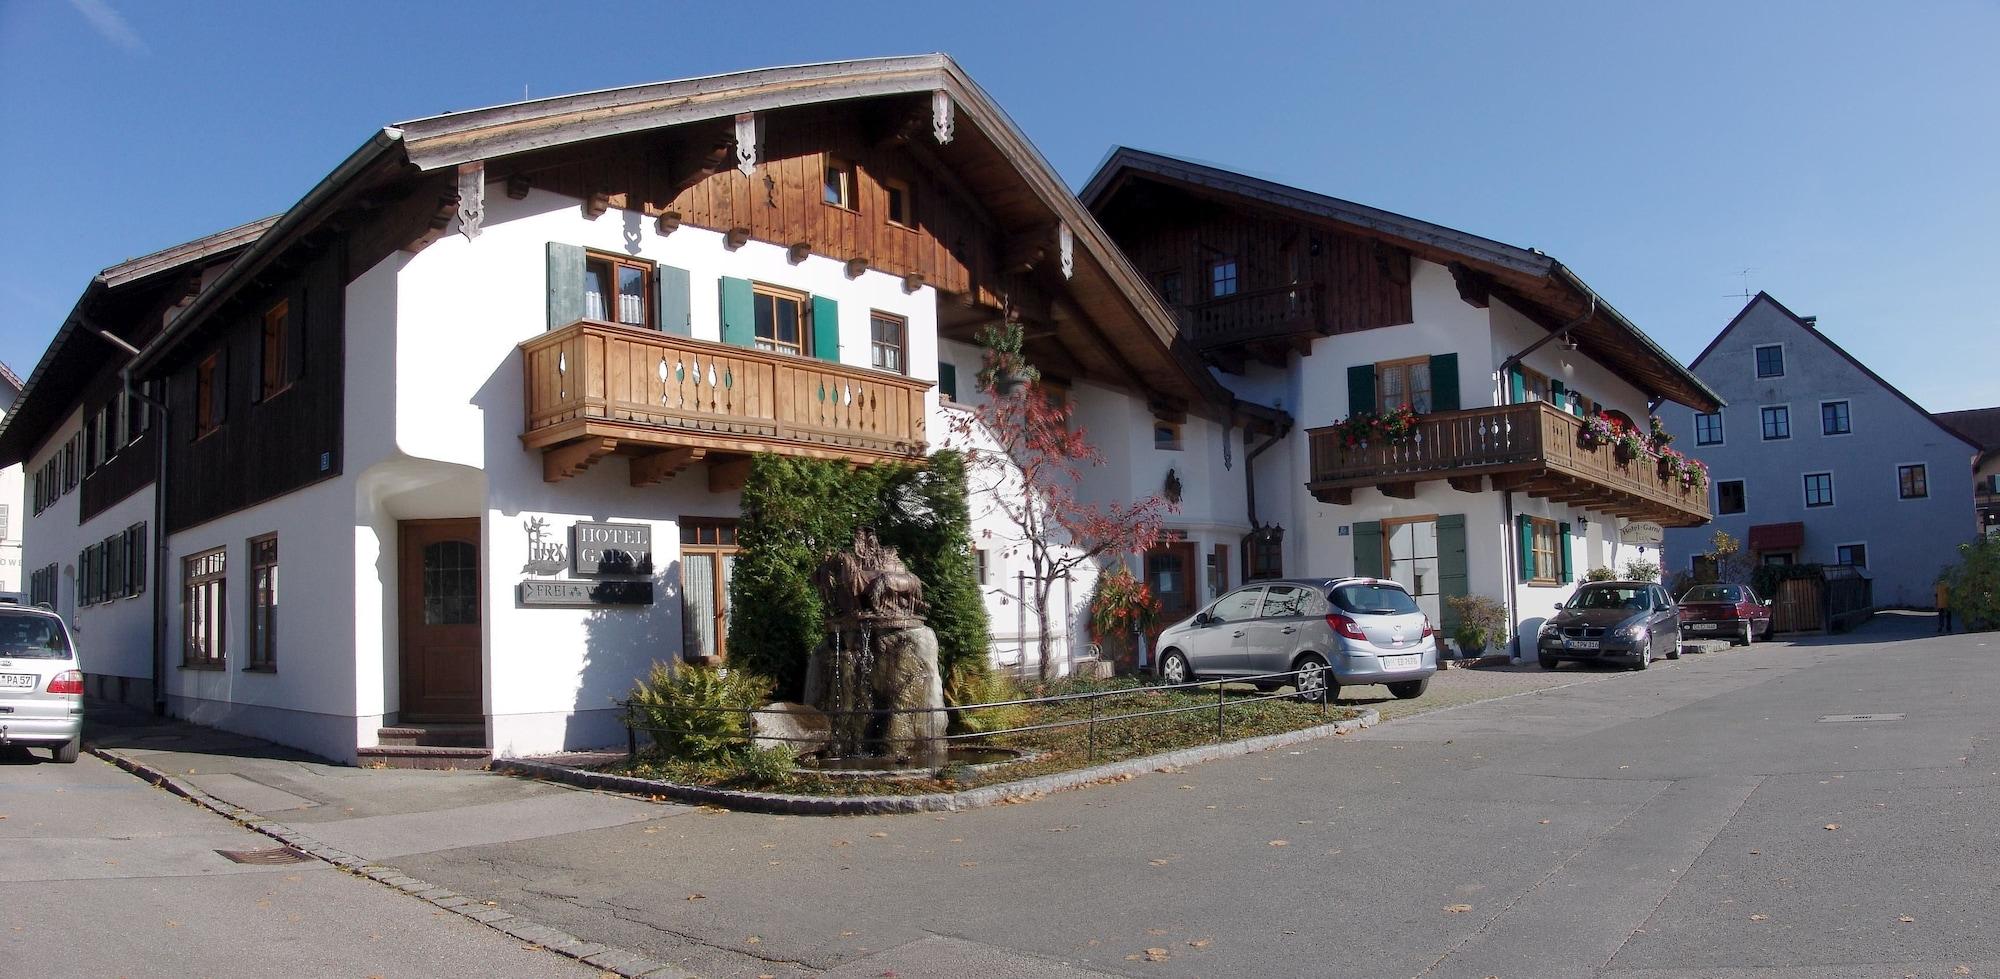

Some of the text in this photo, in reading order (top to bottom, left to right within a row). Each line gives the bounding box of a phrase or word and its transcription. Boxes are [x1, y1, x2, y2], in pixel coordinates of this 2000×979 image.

[581, 528, 648, 545] HOTEL
[581, 548, 646, 563] GARNI
[537, 585, 566, 597] FREI
[6, 675, 31, 685] PA 57
